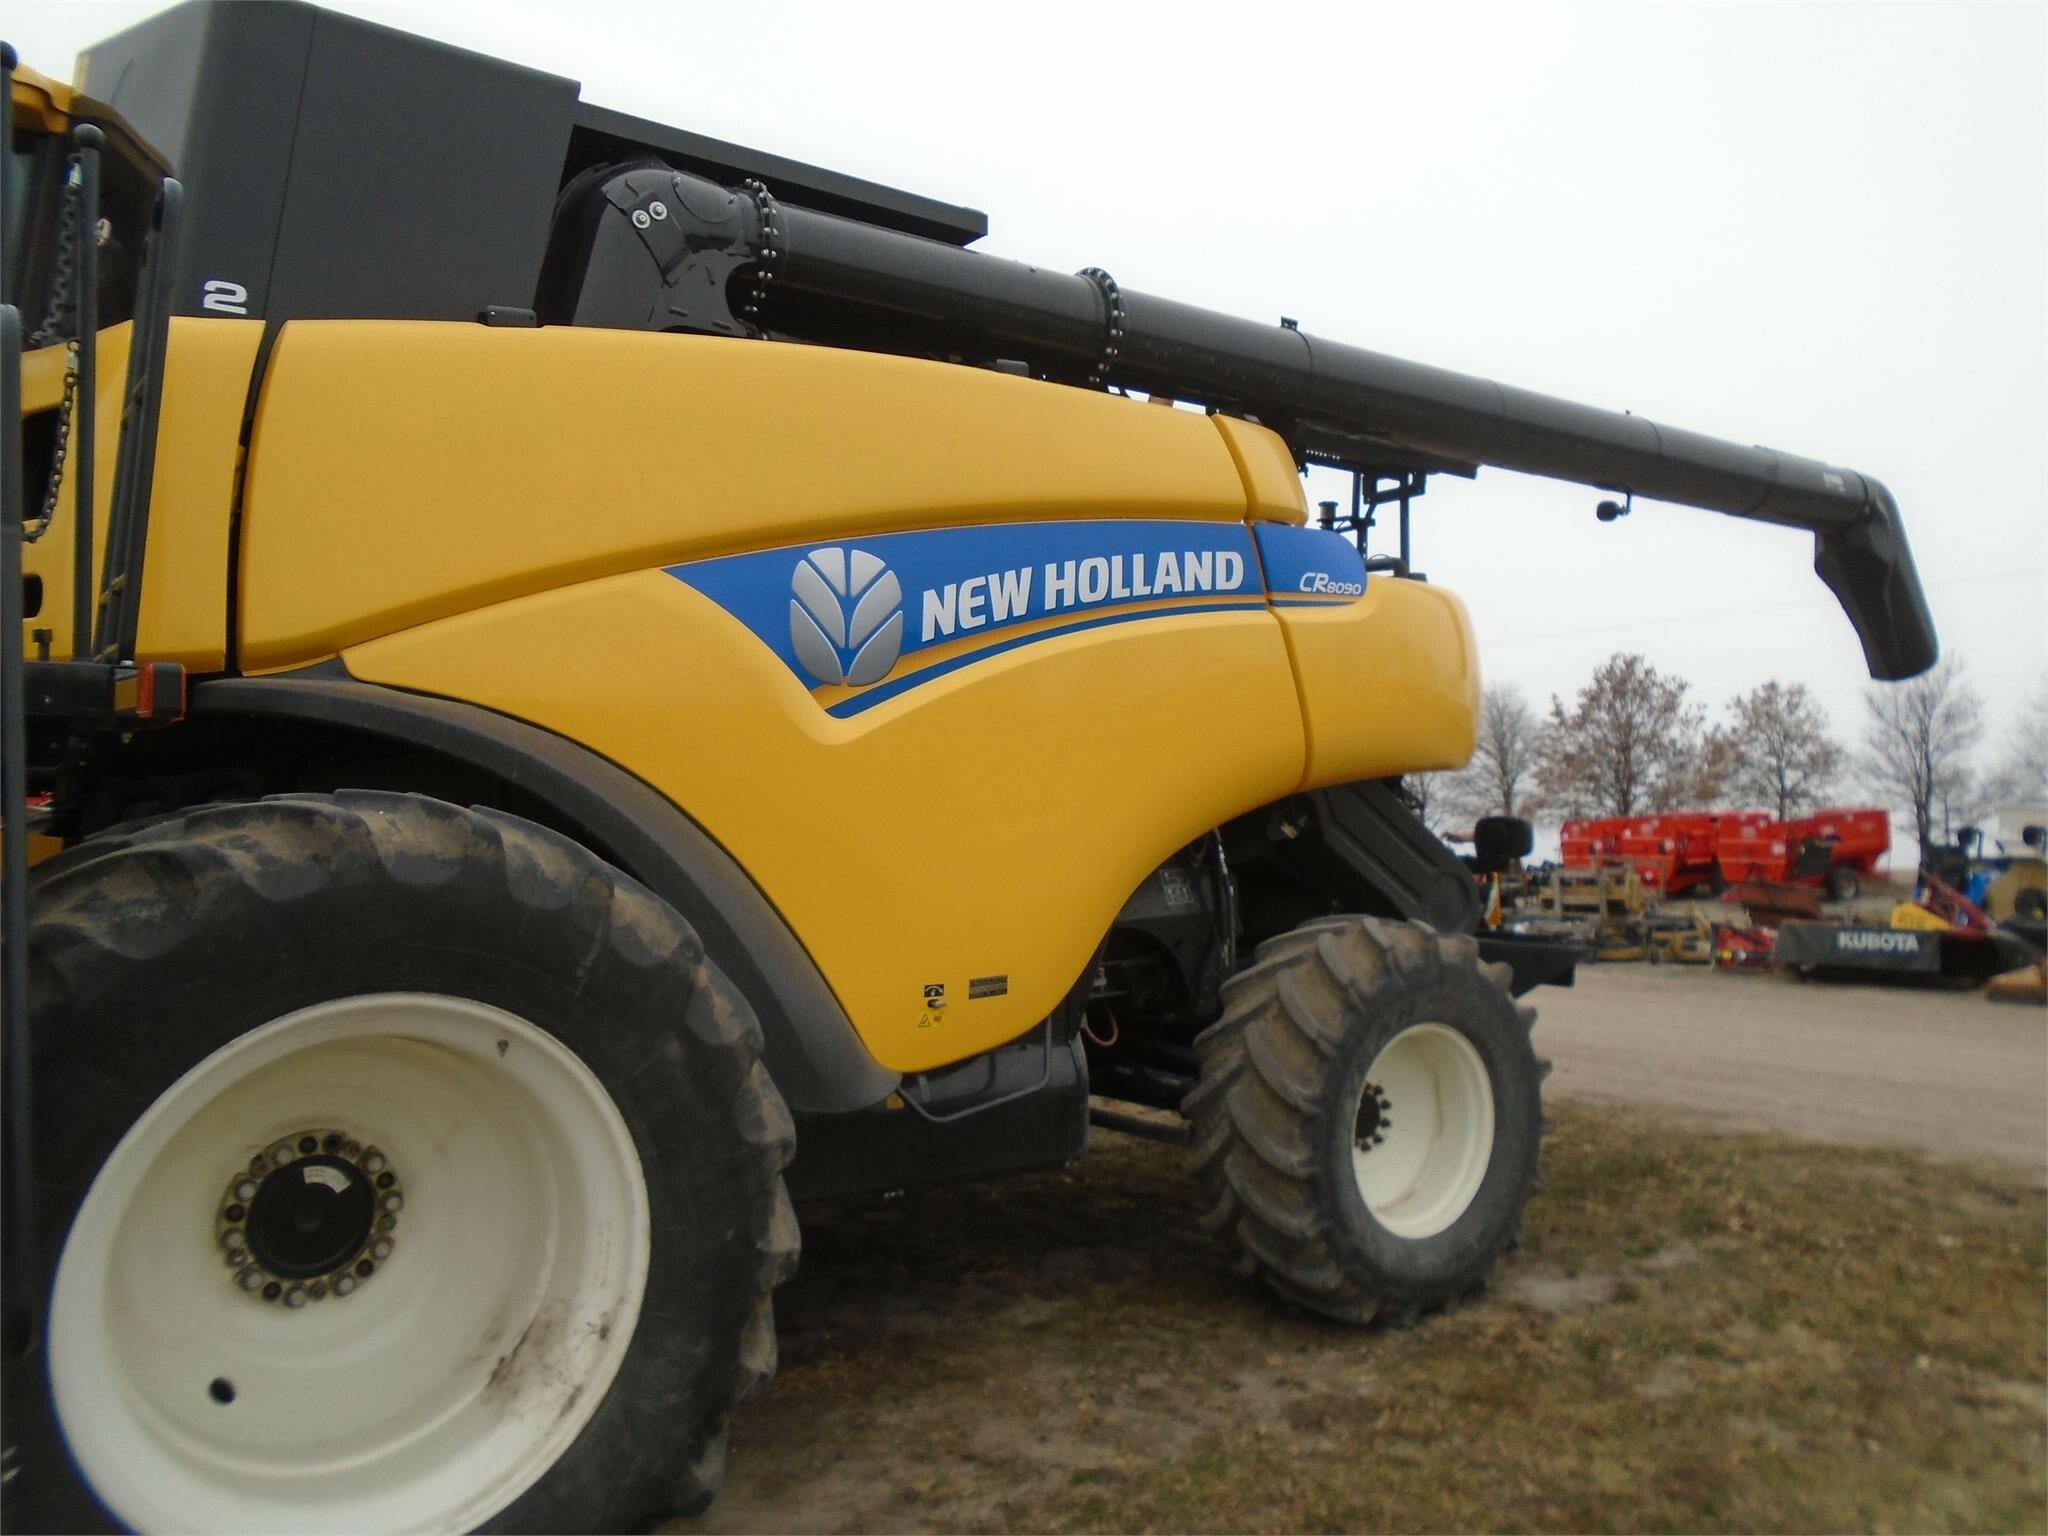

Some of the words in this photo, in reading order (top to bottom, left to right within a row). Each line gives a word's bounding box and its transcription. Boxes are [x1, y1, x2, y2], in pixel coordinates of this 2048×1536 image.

[203, 280, 248, 315] 2
[921, 566, 1033, 642] NEW
[1044, 551, 1244, 610] HOLLAND
[1299, 571, 1362, 595] CR8090
[1837, 930, 1920, 952] KUBOTA
